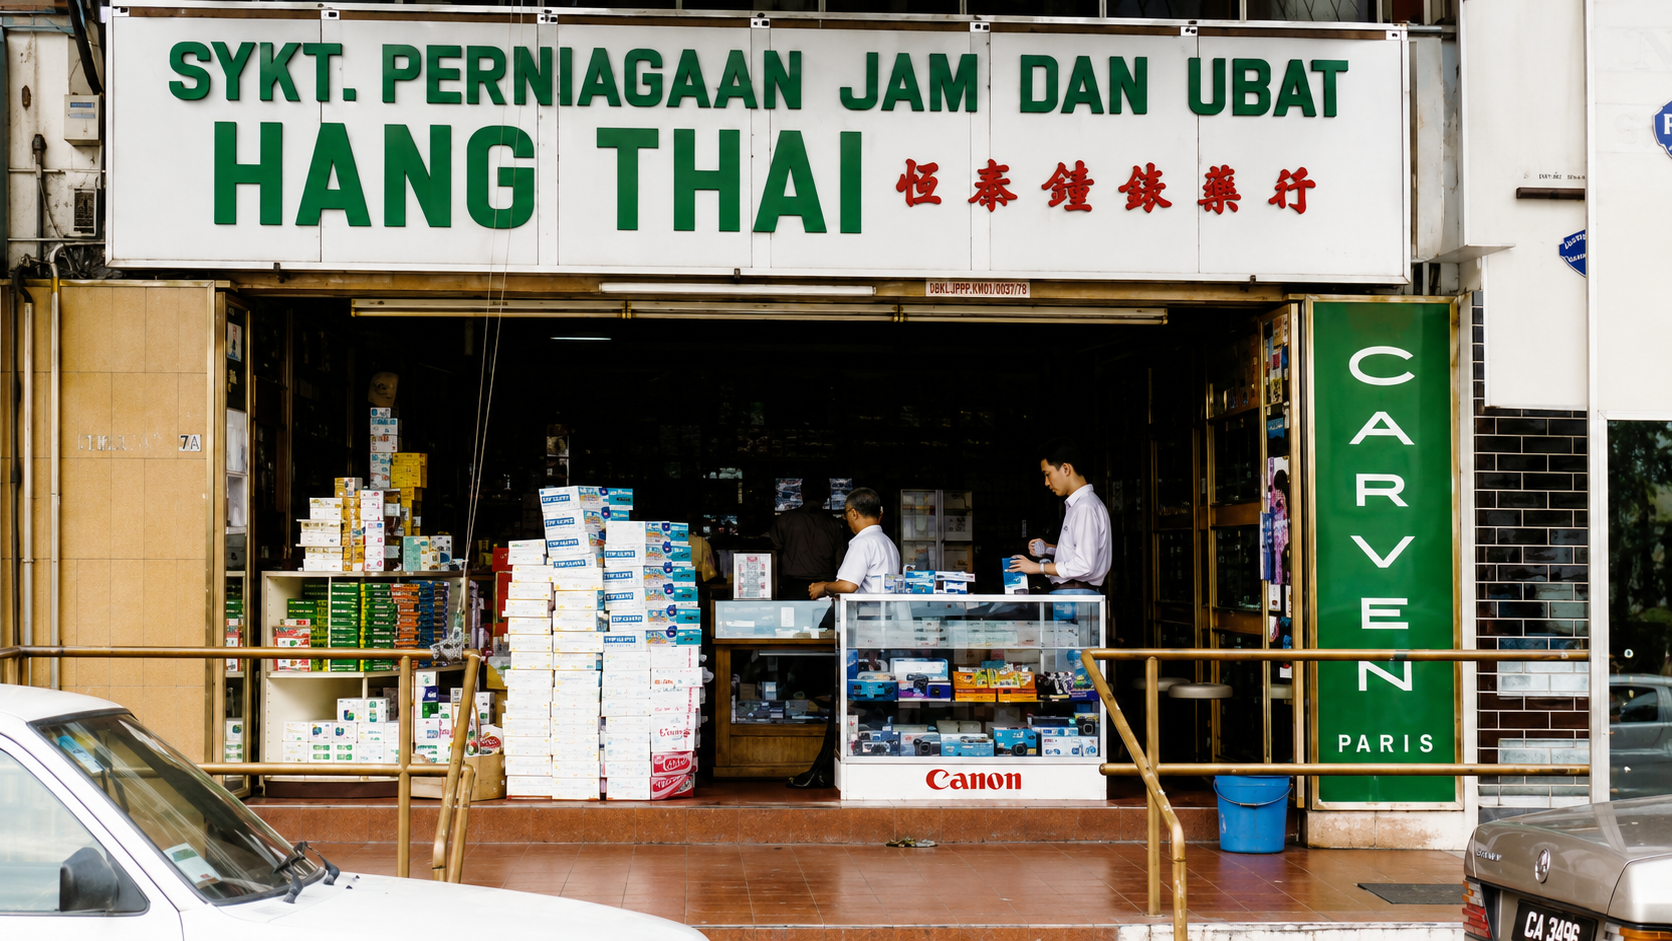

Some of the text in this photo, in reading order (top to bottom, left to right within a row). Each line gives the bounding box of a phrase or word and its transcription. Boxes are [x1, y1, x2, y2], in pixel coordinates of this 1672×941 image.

[169, 41, 1349, 117] SYKT. PERNIAGAAN JAM DAN UBAT
[214, 121, 862, 234] HANG THAI
[180, 435, 200, 450] 7A
[1348, 345, 1416, 692] CARVEN
[1338, 734, 1434, 753] PARIS
[925, 768, 1022, 791] Canon
[1523, 911, 1581, 941] CA 3496
